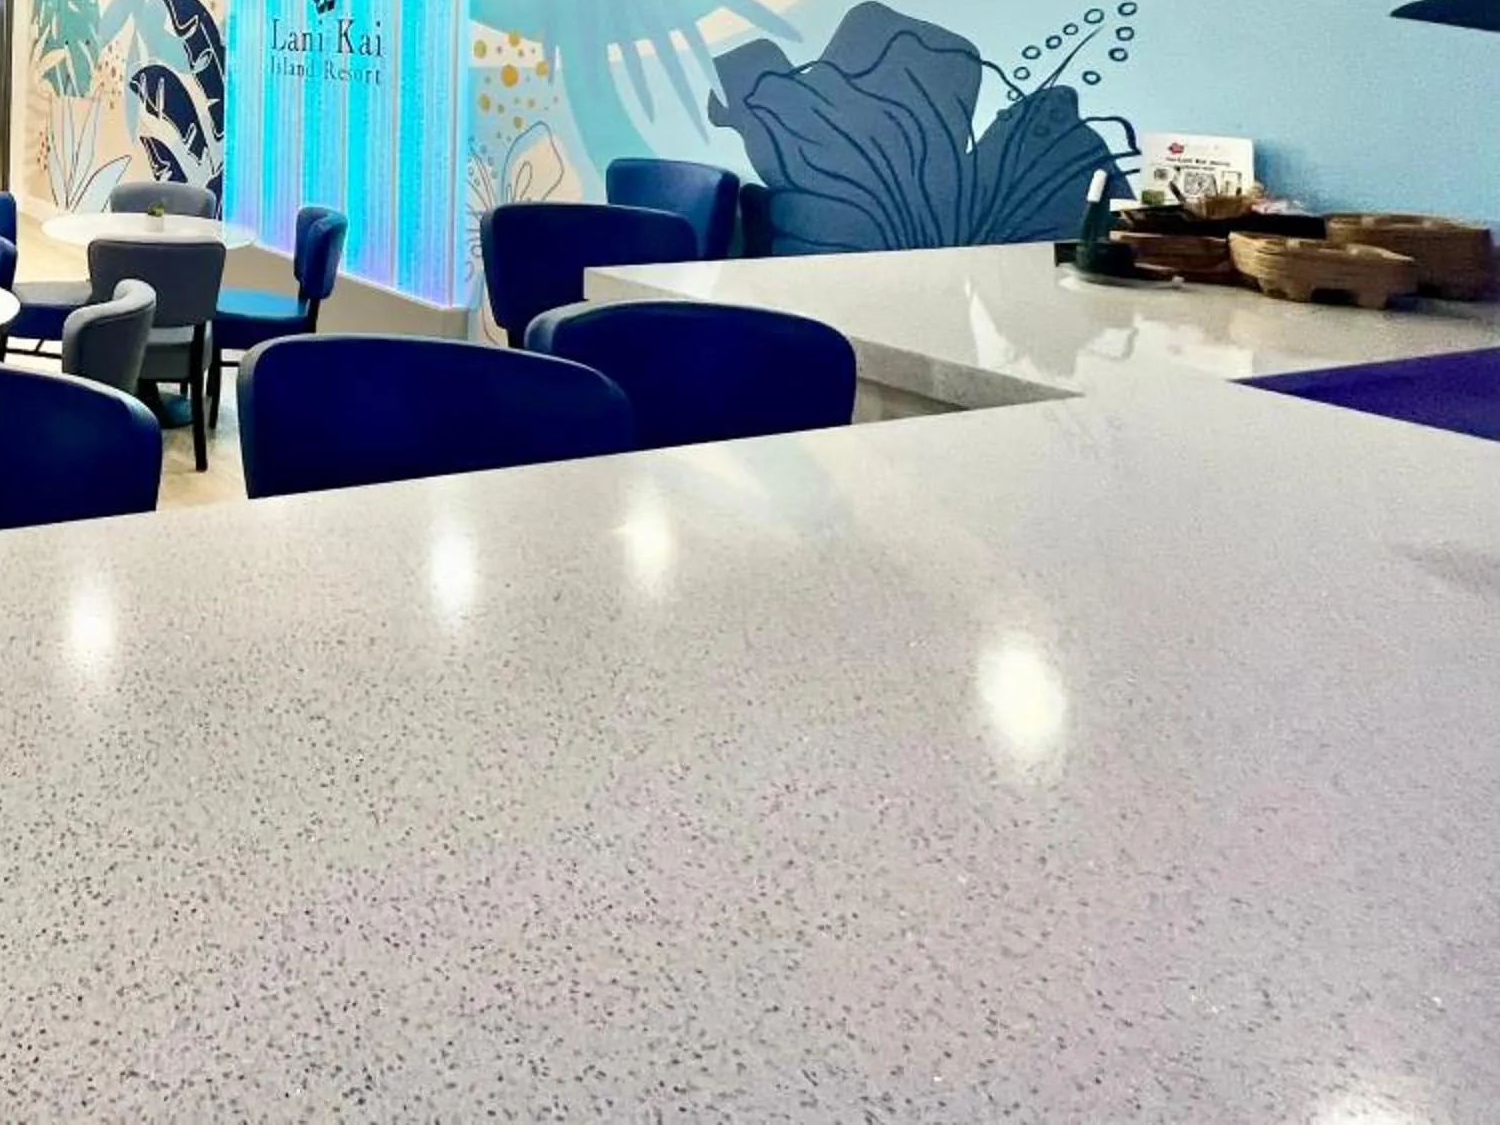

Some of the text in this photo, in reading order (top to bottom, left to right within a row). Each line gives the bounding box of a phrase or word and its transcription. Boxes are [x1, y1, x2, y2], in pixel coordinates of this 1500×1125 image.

[271, 18, 383, 57] Lani Kai
[271, 55, 380, 84] Island Resort
